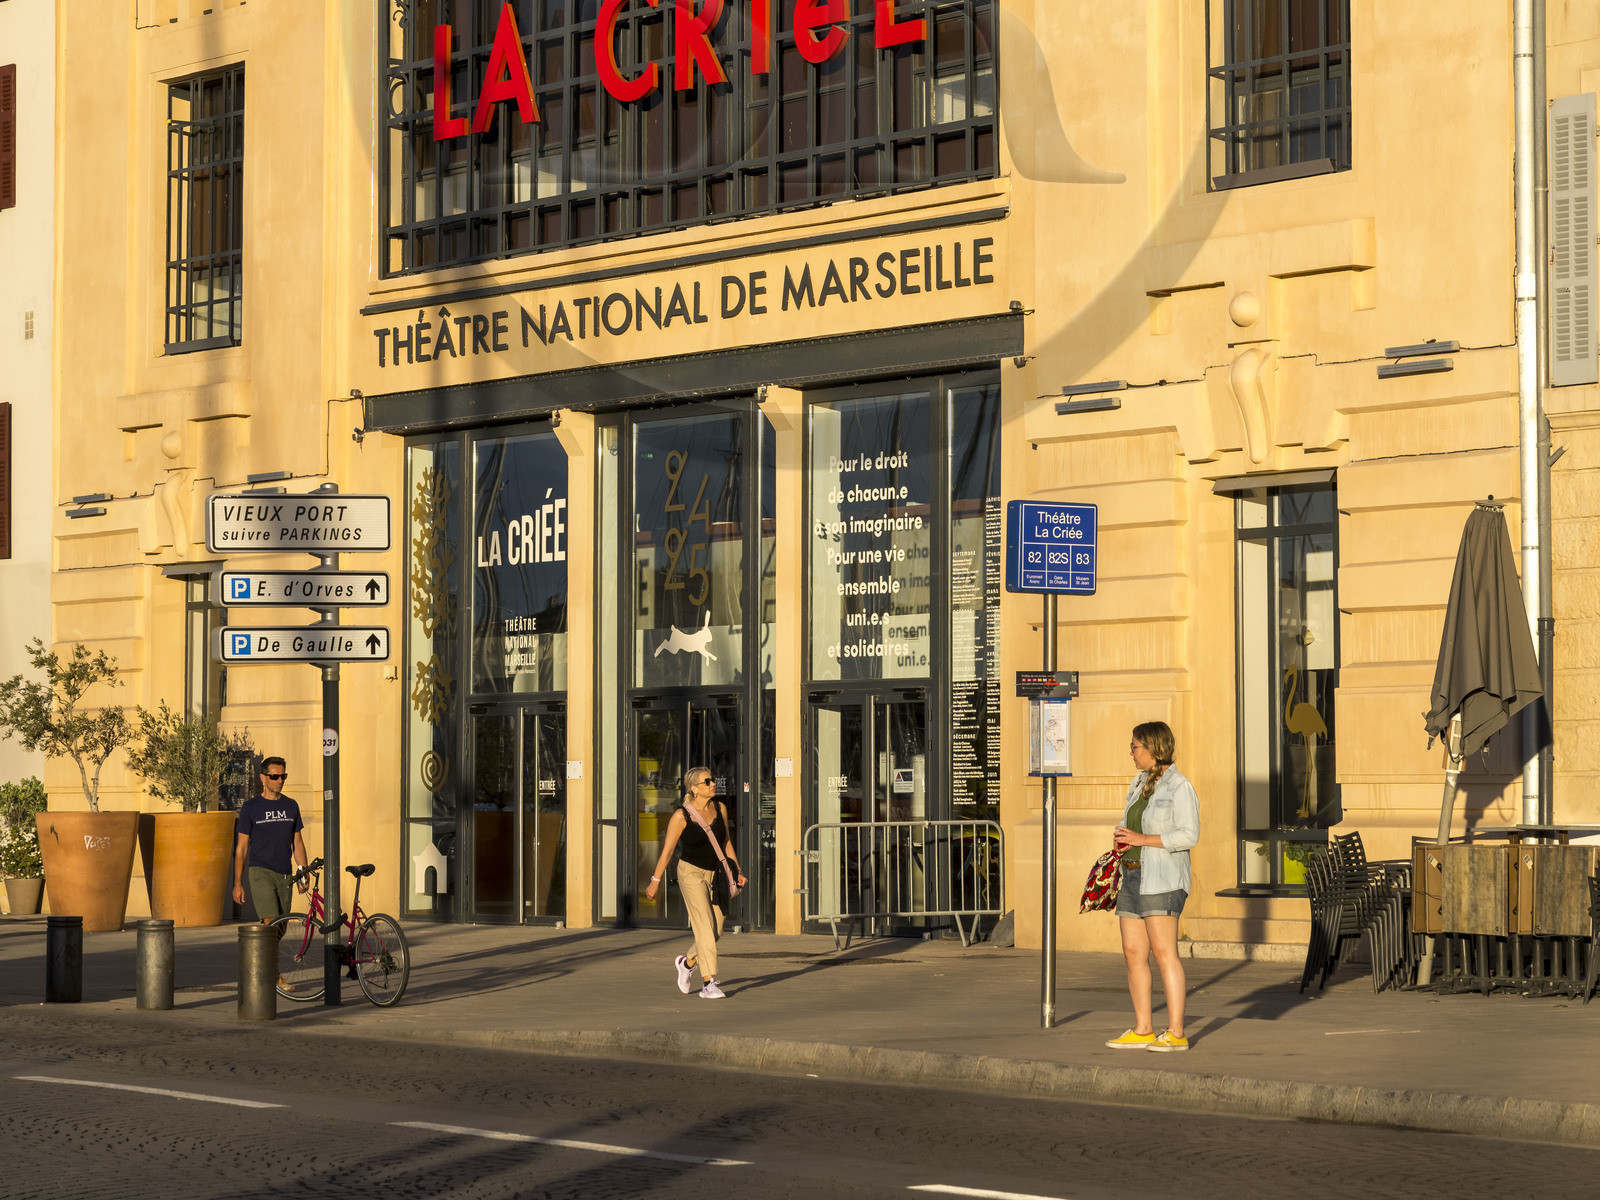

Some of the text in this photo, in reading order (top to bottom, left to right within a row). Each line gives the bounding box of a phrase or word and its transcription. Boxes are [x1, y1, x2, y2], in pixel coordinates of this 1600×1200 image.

[433, 2, 541, 142] LA
[374, 237, 994, 368] THÉÂTRE NATIONAL DE MARSEILLE
[829, 451, 908, 473] Pour le droit
[828, 484, 908, 504] de chacun.e
[223, 505, 348, 522] VIEUX PORT
[1037, 511, 1081, 525] Théâtre
[477, 488, 567, 568] LA CRIÉE
[825, 520, 847, 535] son
[850, 512, 923, 537] imaginaire
[1035, 525, 1083, 539] La Criée
[222, 527, 362, 541] suivre PARKINGS
[827, 547, 856, 566] Pour
[858, 549, 882, 563] une
[884, 545, 906, 562] vie
[1028, 551, 1042, 563] 82
[1048, 552, 1069, 564] 82S
[1075, 552, 1090, 565] 83
[257, 581, 354, 597] E. d'Orves
[837, 575, 900, 596] ensemble
[505, 616, 537, 632] THÉÂTRE
[846, 608, 890, 627] uni.e.s
[257, 636, 353, 652] De Gaulle
[505, 635, 536, 649] NATIONAL
[827, 638, 909, 658] et solidaires
[505, 653, 536, 667] MARSEILLE
[828, 774, 848, 788] ENTRÉE
[265, 810, 287, 820] PLM
